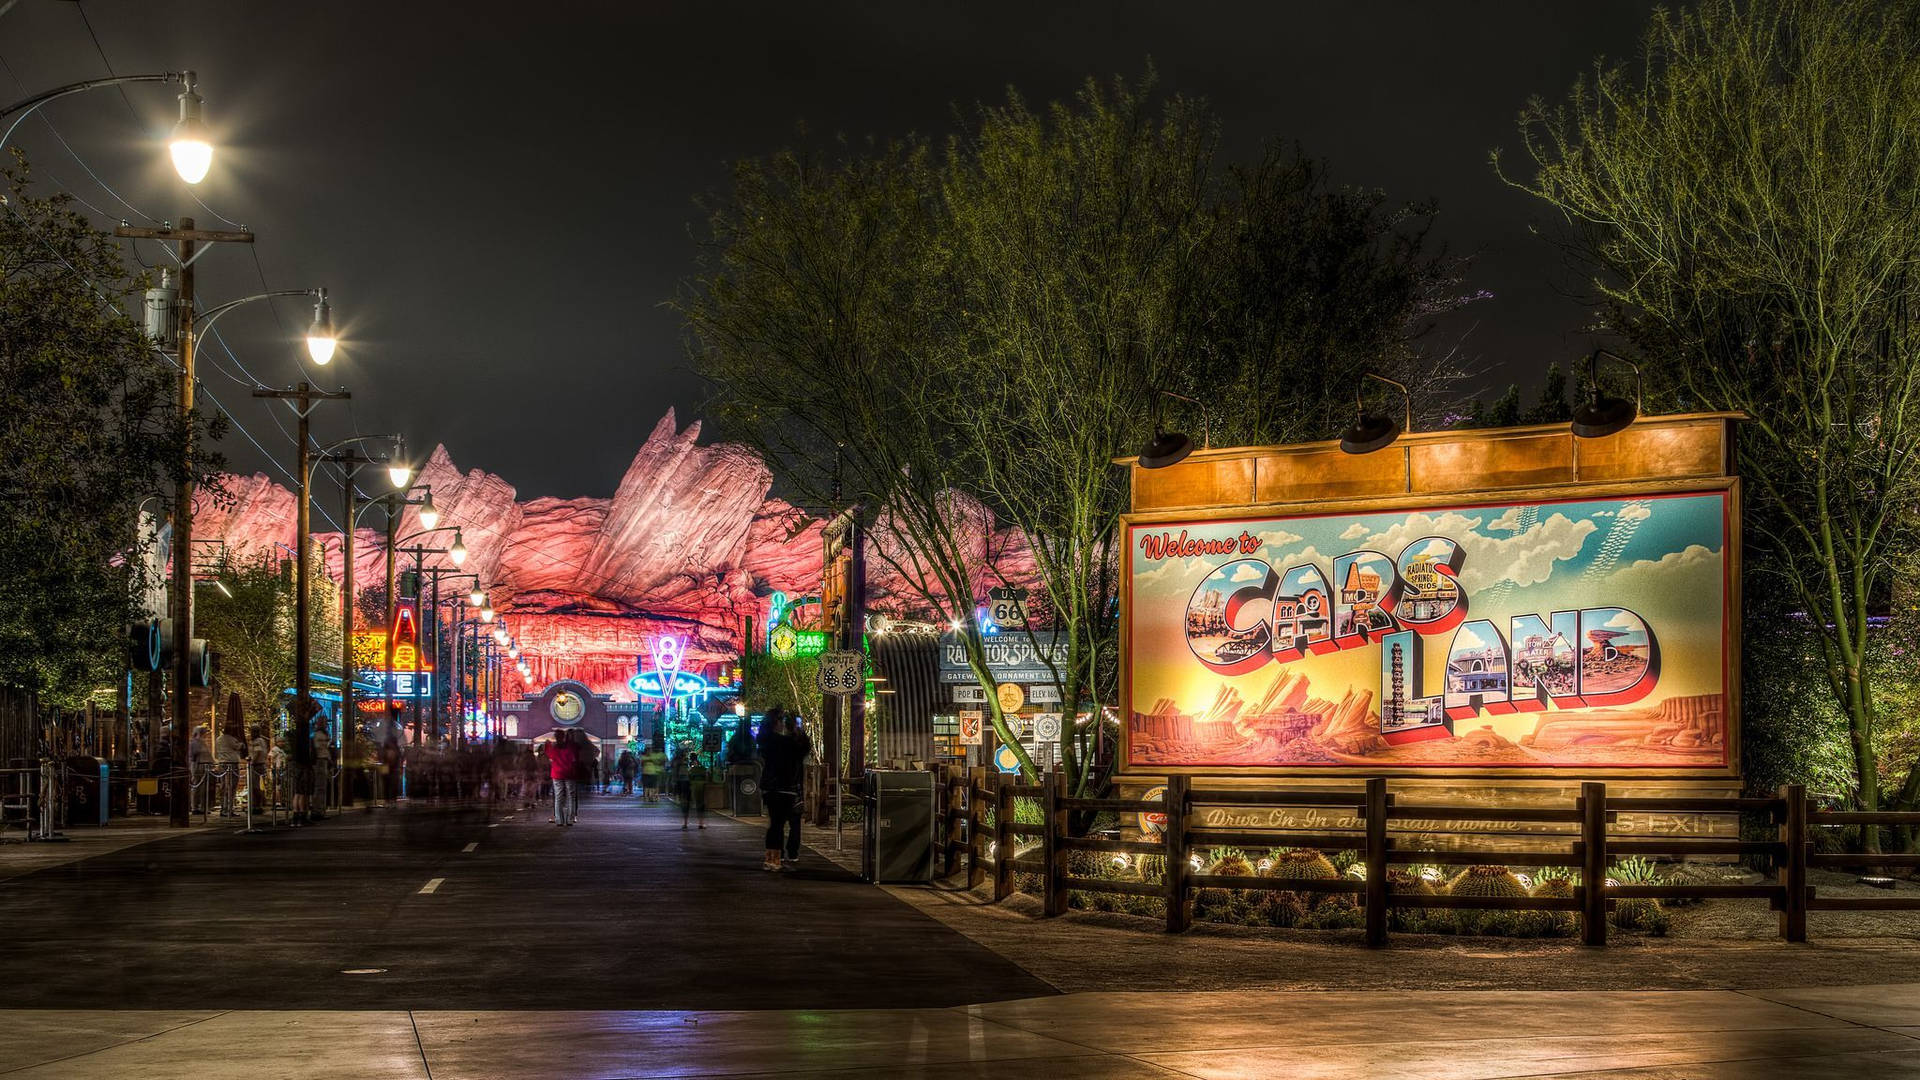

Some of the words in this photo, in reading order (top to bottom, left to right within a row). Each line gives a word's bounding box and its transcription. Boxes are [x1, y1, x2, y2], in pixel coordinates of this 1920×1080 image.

[1140, 530, 1237, 560] Welcome
[1238, 531, 1263, 554] to
[995, 603, 1020, 620] 66
[1185, 536, 1468, 674] CARS
[983, 635, 1018, 643] WELCOME
[827, 655, 854, 665] ROUTE
[946, 644, 1010, 665] RATOR
[824, 667, 857, 688] 66
[1380, 606, 1661, 745] LAND
[1207, 808, 1262, 828] Drive
[1268, 809, 1297, 828] On
[1337, 815, 1367, 828] an
[1649, 815, 1721, 833] EXIT
